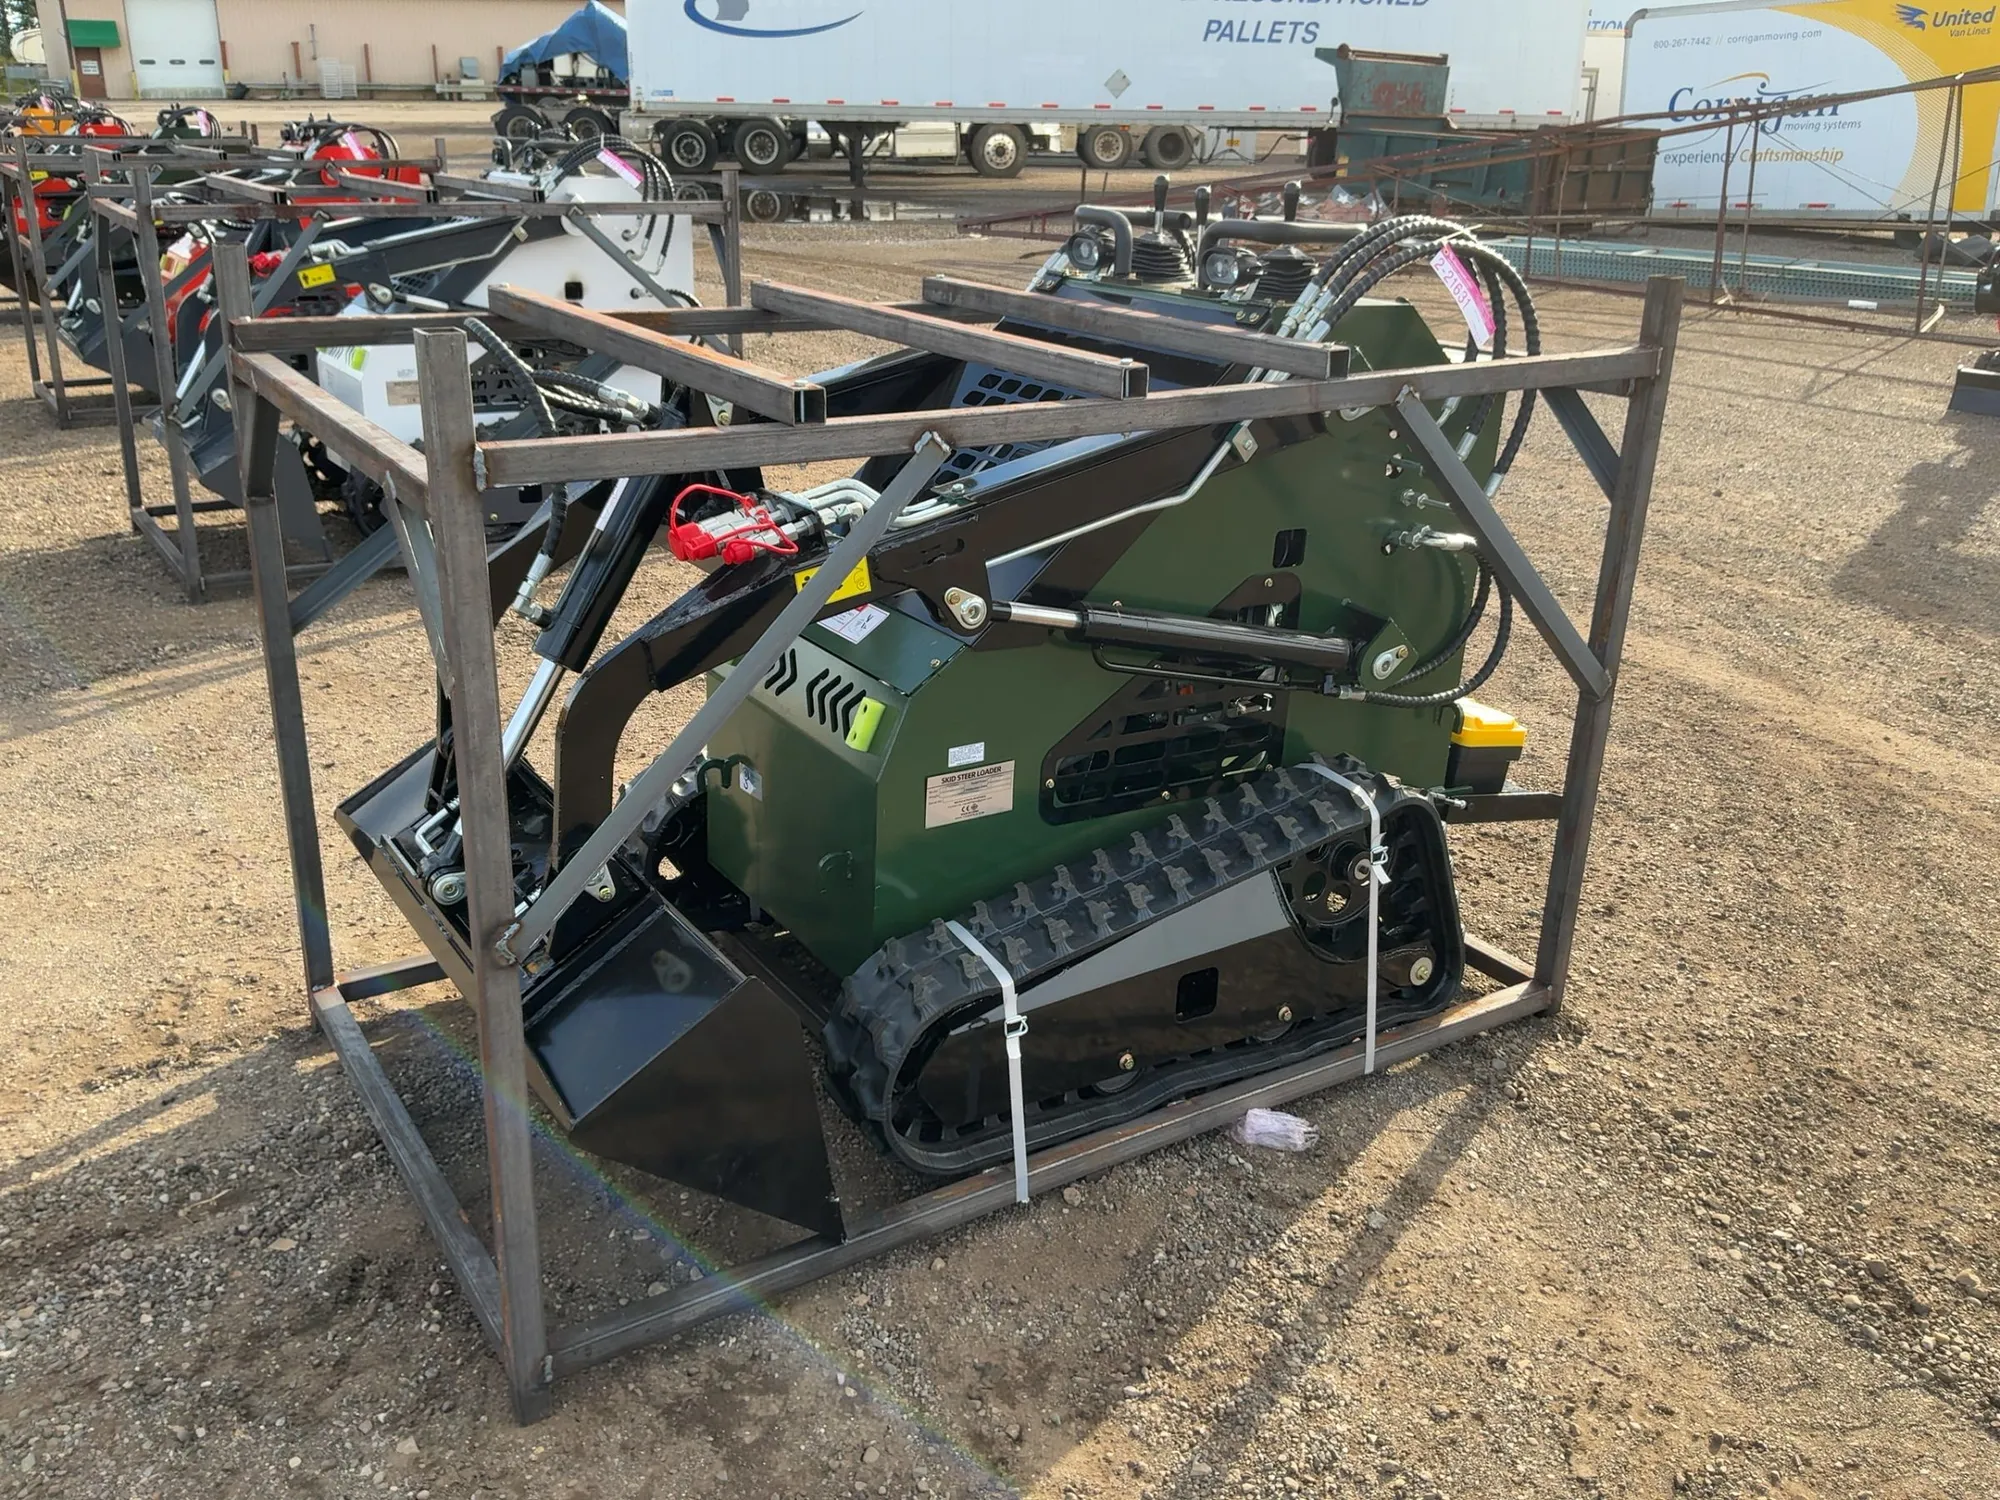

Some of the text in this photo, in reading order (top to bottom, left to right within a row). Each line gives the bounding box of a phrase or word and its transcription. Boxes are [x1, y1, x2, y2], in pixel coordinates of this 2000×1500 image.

[1932, 6, 1996, 27] United
[1202, 19, 1320, 44] PALLETS
[1653, 36, 1711, 49] 800-267-7442
[1727, 29, 1822, 44] corriganmoving.com
[1950, 27, 1992, 37] Van Lines
[1784, 119, 1862, 132] moving systems
[1740, 147, 1844, 165] Caftsmanship
[1434, 258, 1471, 308] 2-21631
[941, 766, 1002, 784] SKID STEER LOADER
